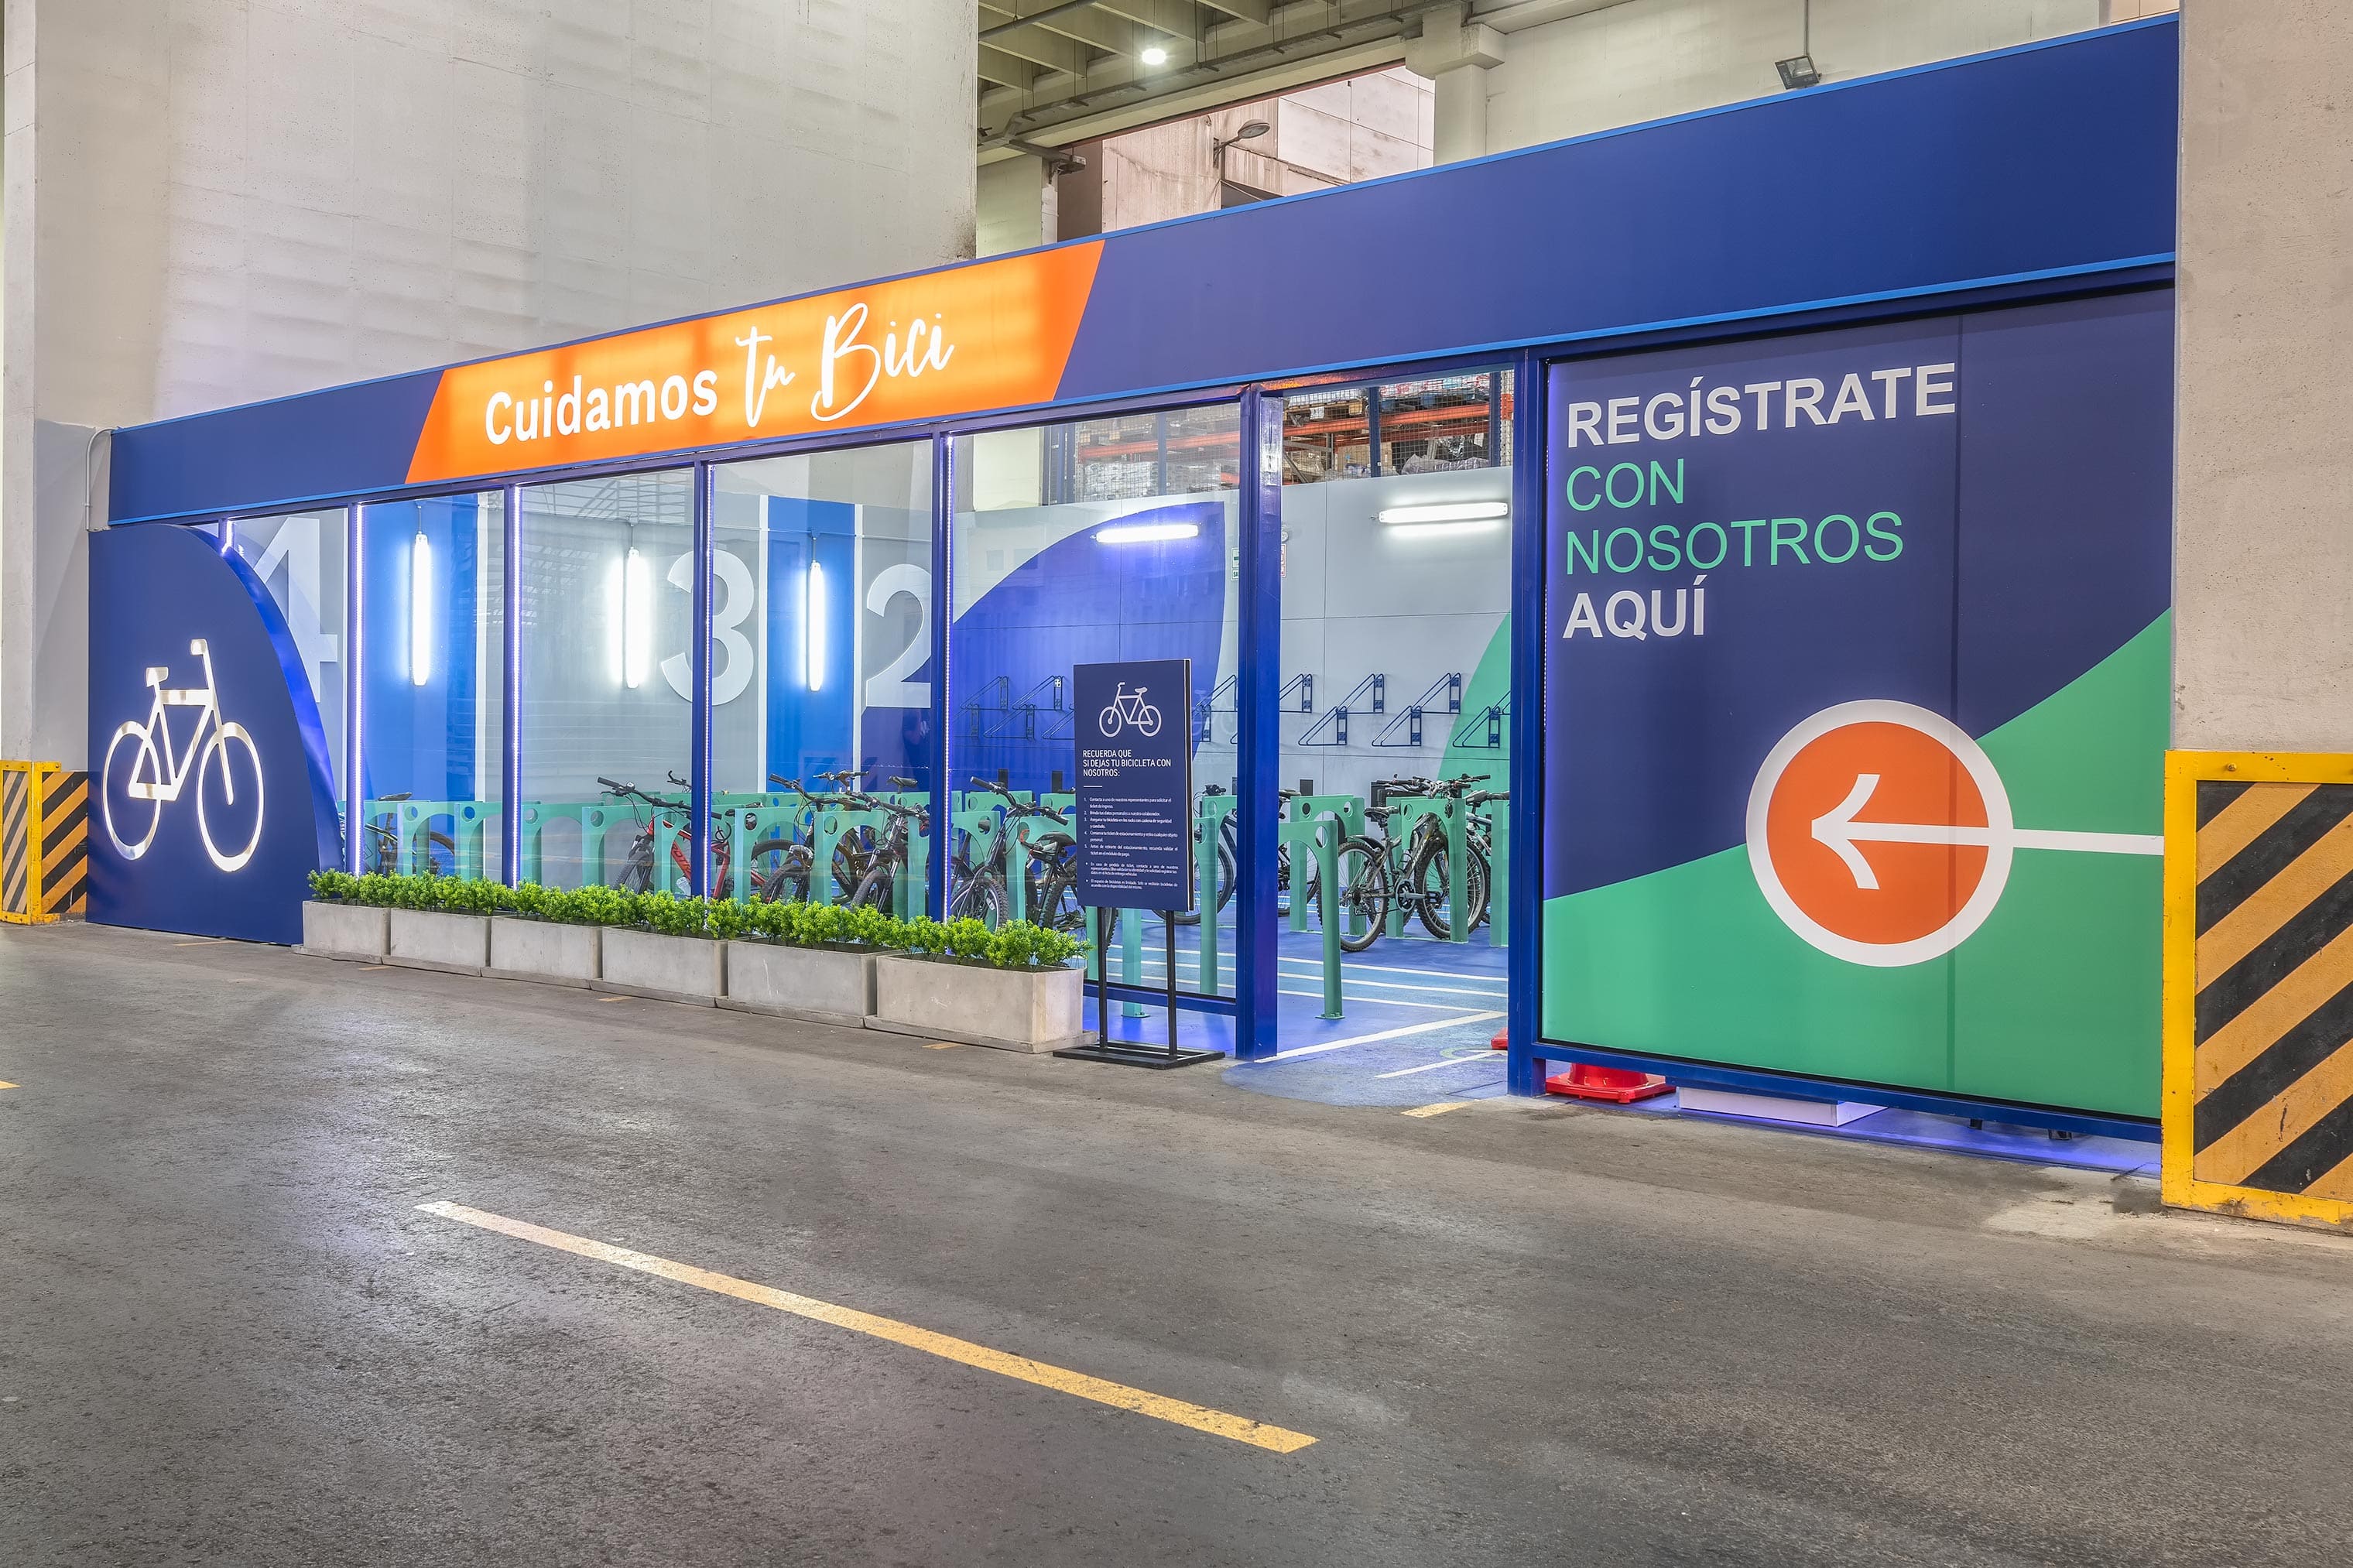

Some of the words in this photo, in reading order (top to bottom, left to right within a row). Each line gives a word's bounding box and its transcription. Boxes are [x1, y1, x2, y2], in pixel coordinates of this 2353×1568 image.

[486, 370, 718, 445] Cuidamos
[735, 325, 796, 428] tu
[811, 303, 955, 422] Bici
[1567, 362, 1956, 448] REGÍSTRATE
[1567, 459, 1684, 510] CON
[1567, 512, 1903, 575] NOSOTROS
[254, 517, 338, 704] 4
[661, 549, 754, 706] 3
[866, 564, 931, 708] 2
[1562, 574, 1707, 641] AQUÍ
[1083, 749, 1117, 758] RECUERDA
[1118, 749, 1132, 759] QUE
[1083, 769, 1121, 777] NOSOTROS:
[1091, 759, 1110, 768] DEJAS
[1121, 758, 1156, 767] BICICLETA
[1156, 758, 1171, 767] CON
